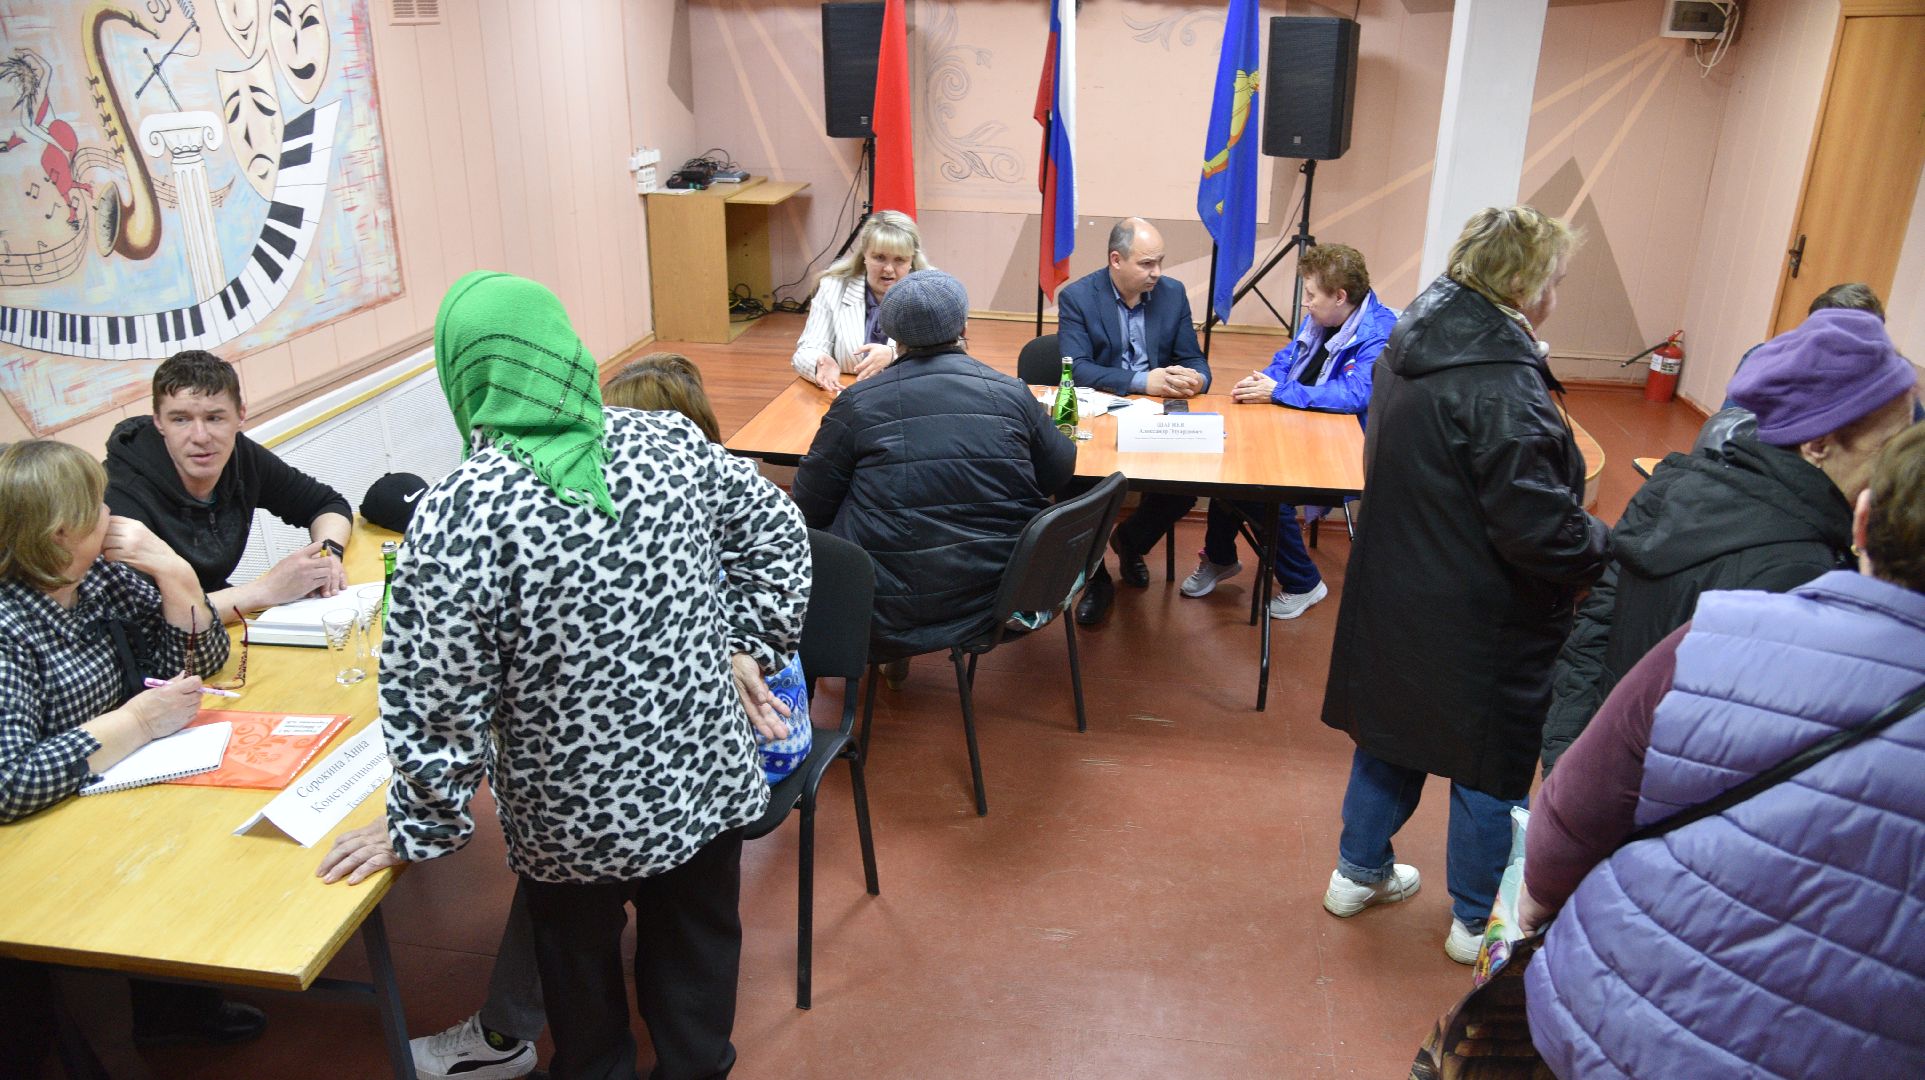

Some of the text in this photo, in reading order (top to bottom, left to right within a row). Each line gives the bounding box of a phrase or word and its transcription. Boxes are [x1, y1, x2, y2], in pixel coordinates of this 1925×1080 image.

[296, 760, 346, 798] Сорокина
[344, 739, 370, 763] Анна
[310, 752, 387, 813] Константиновна
